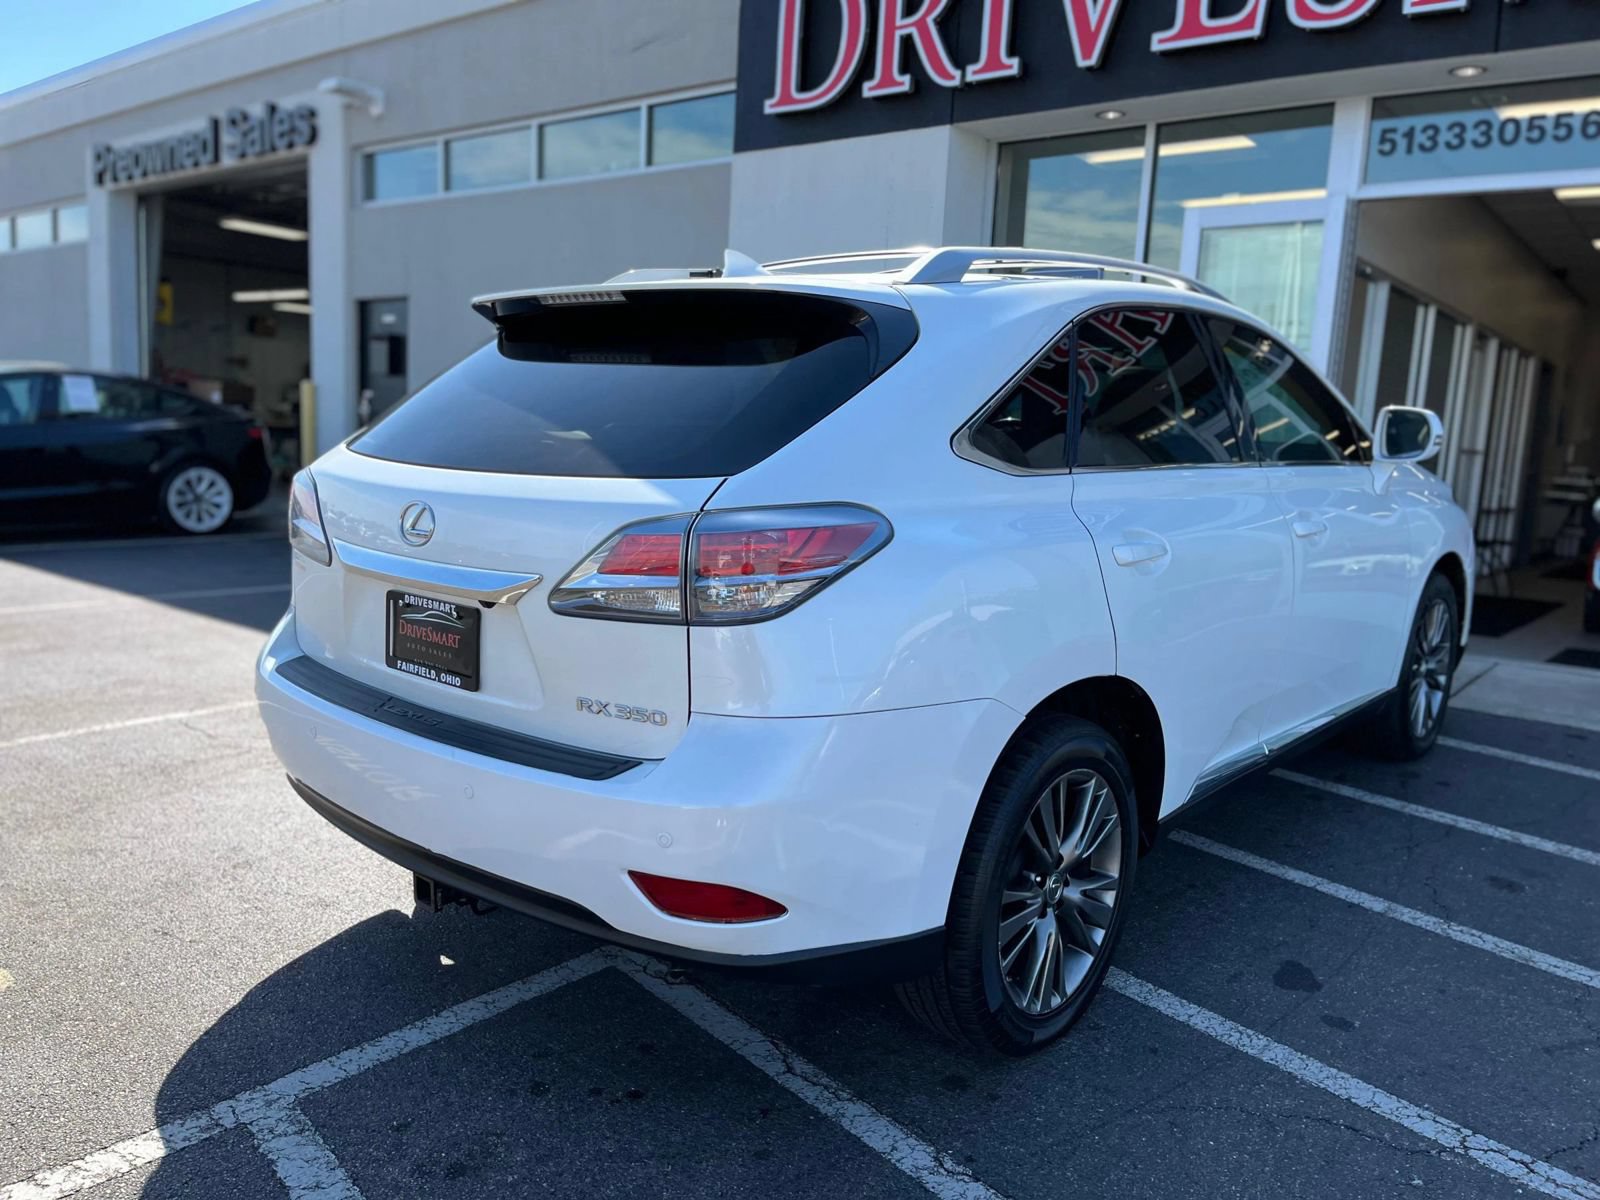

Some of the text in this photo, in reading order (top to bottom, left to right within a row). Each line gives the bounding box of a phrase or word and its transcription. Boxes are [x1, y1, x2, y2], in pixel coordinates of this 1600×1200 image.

[225, 101, 318, 160] Sales
[404, 594, 456, 614] DRIVESMART
[397, 660, 439, 681] FAIRFIELD,
[440, 672, 461, 686] OHIO
